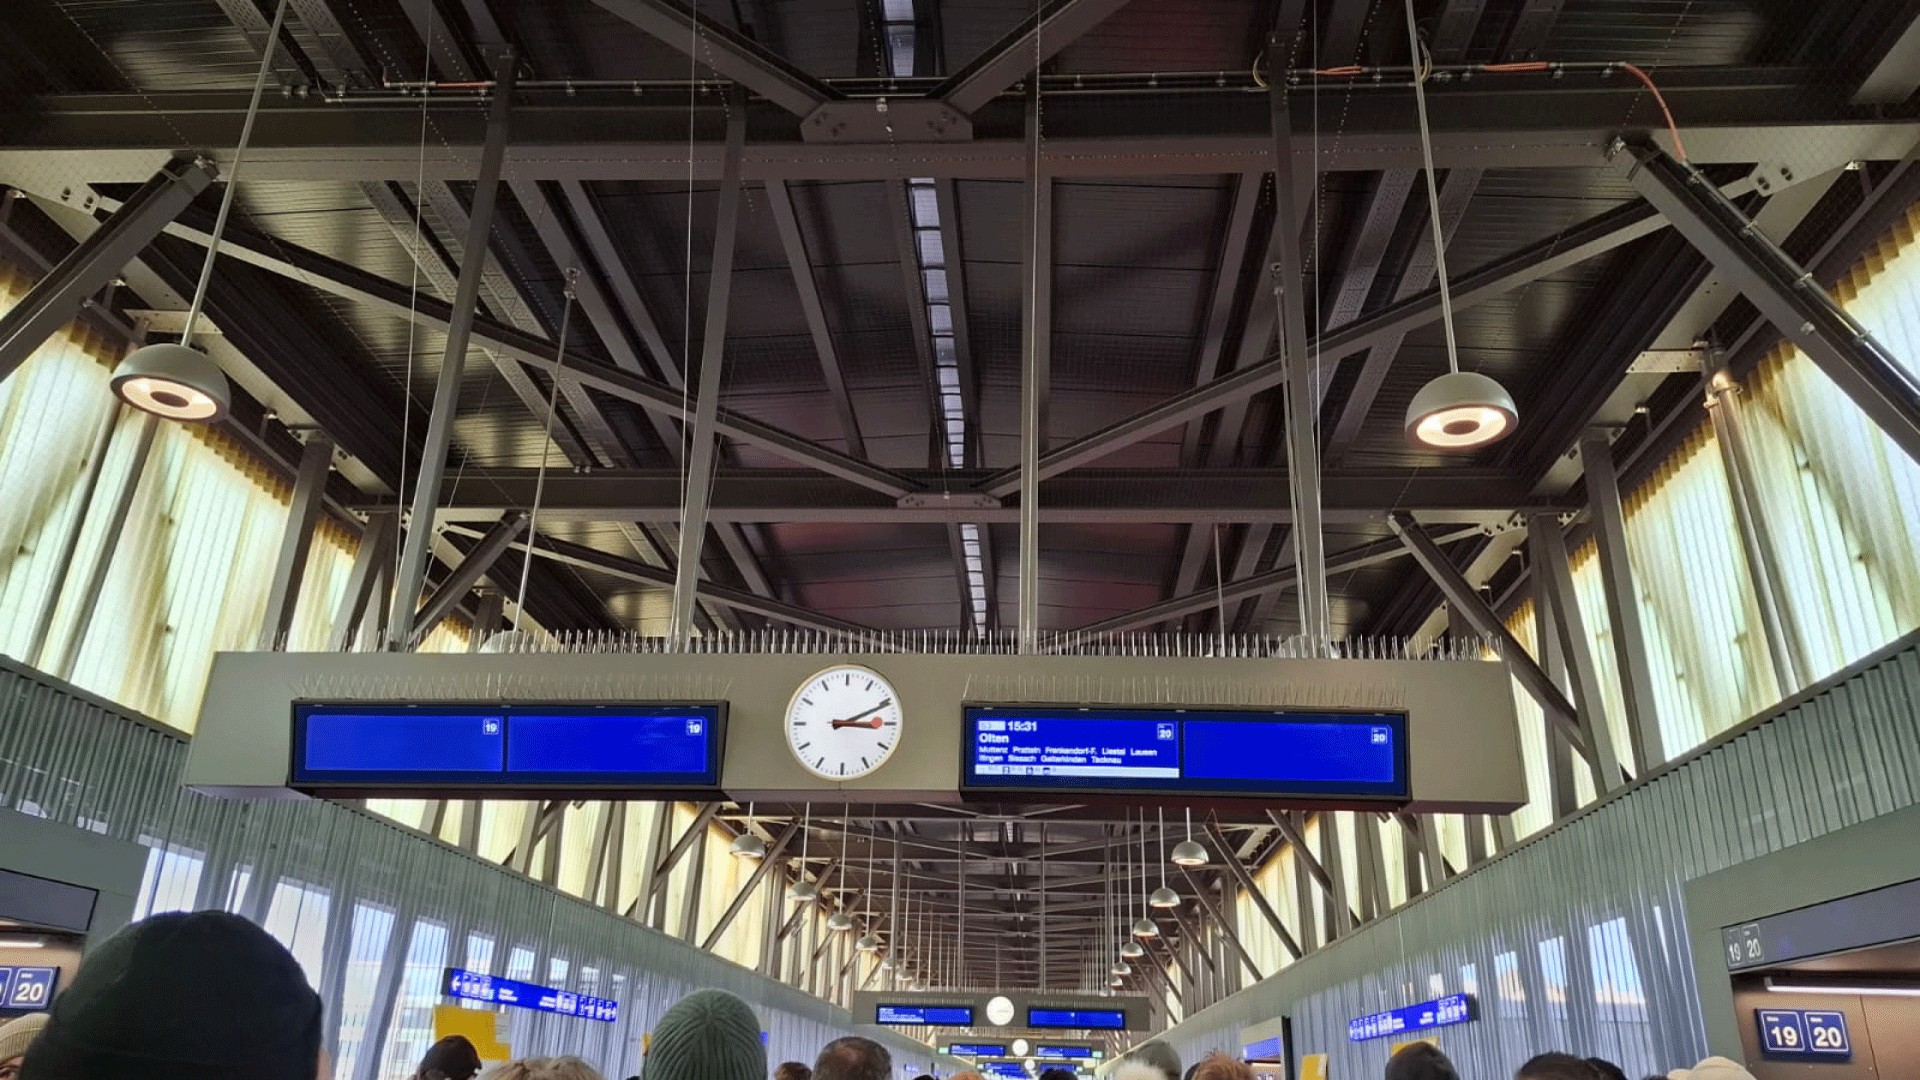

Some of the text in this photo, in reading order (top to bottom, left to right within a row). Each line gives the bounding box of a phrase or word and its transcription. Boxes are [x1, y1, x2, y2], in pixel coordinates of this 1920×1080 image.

[486, 723, 498, 732] 19
[689, 724, 701, 734] 19
[1007, 720, 1038, 732] 15:31
[979, 733, 1010, 744] Olten
[1159, 729, 1172, 739] 20
[1373, 733, 1386, 743] 20
[1729, 937, 1761, 961] 19 20
[15, 982, 44, 1002] 20
[1771, 1025, 1842, 1048] 19 20
